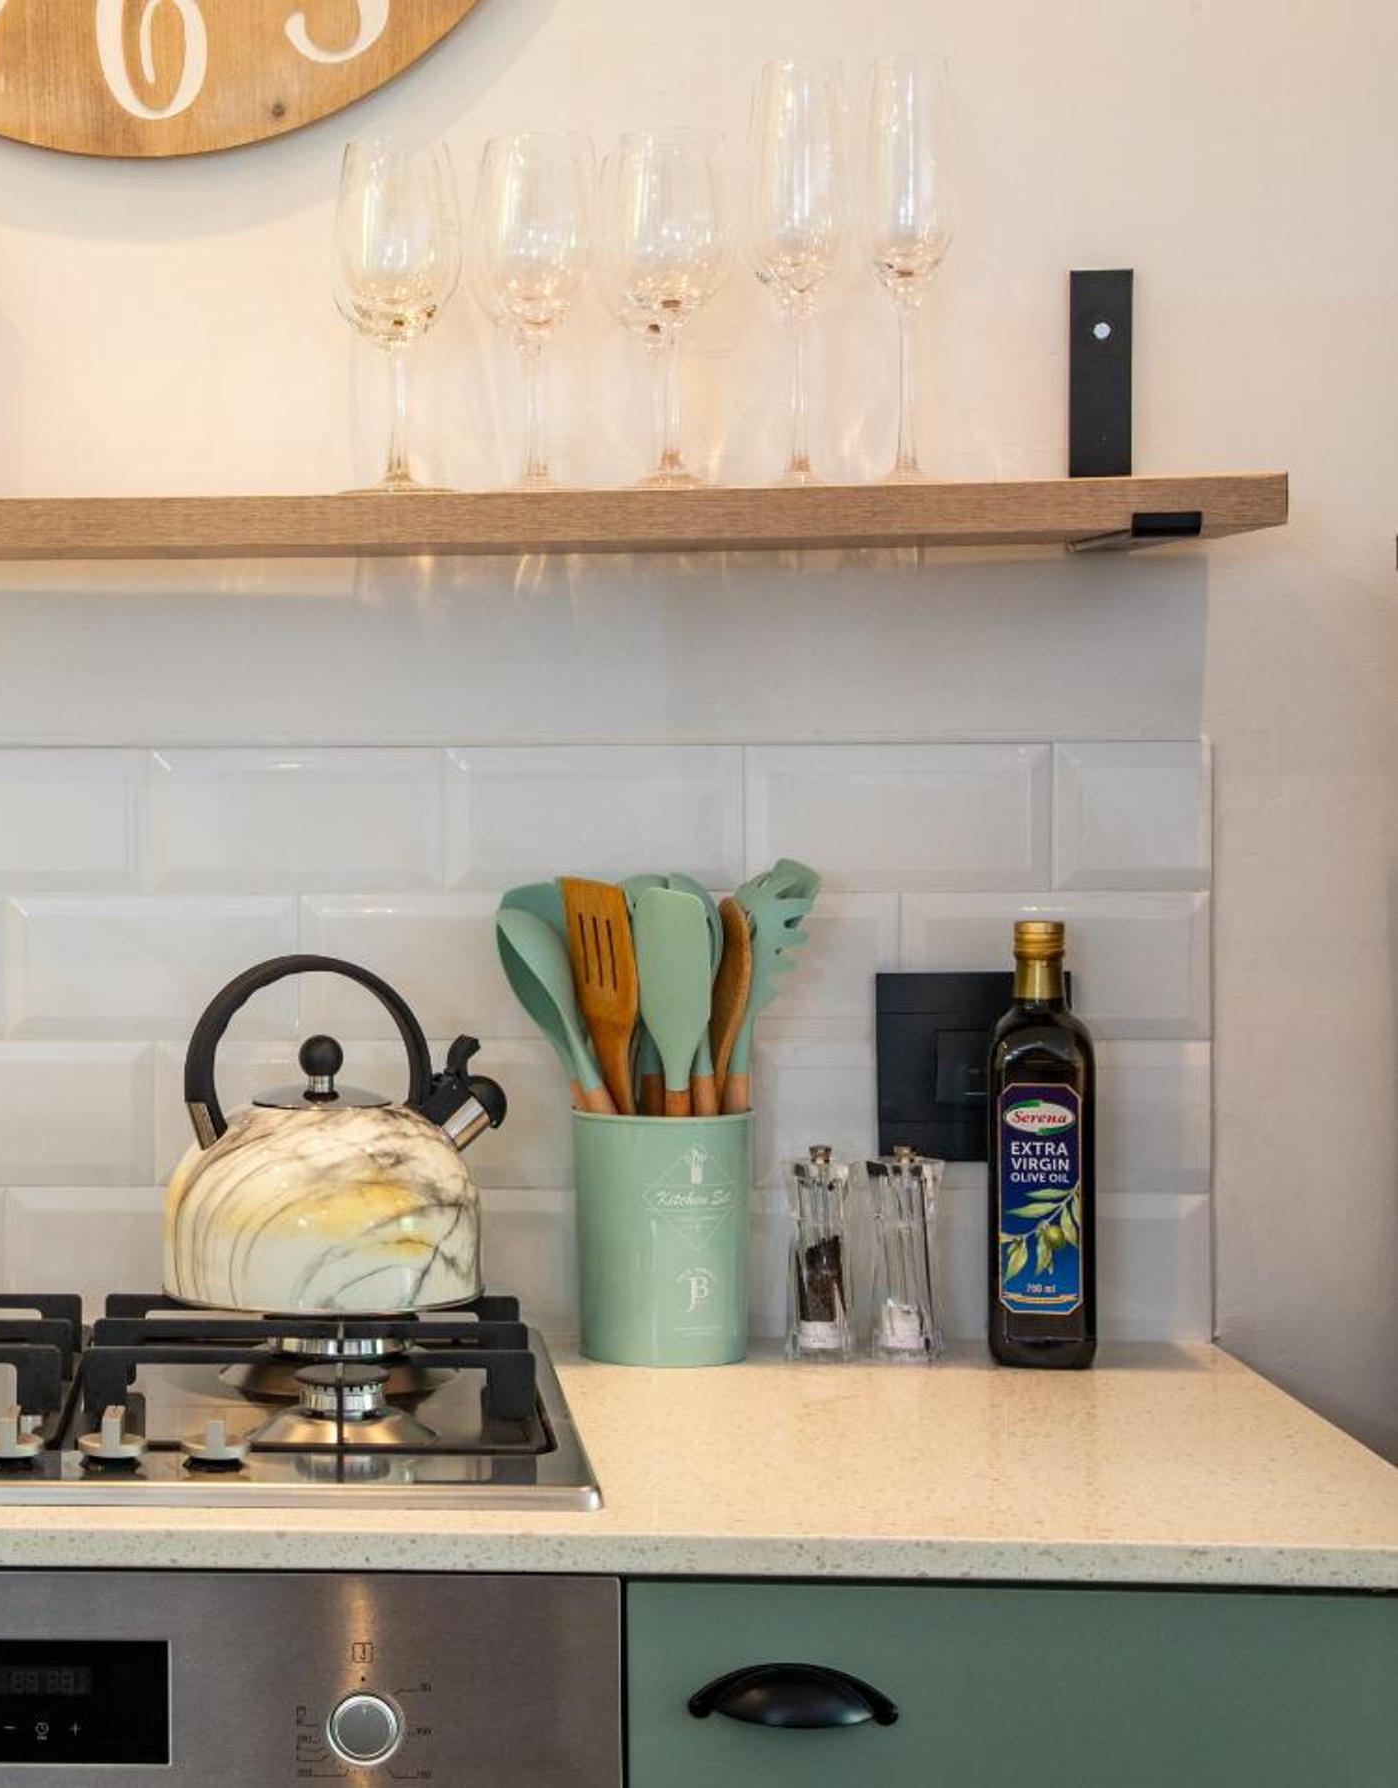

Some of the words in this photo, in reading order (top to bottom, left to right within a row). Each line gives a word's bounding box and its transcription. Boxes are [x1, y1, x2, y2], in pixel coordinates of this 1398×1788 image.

[1012, 1109, 1068, 1124] Serena
[1011, 1141, 1069, 1156] EXTRA
[1011, 1157, 1070, 1171] VIRGIN
[1010, 1172, 1046, 1183] OLIVE
[1049, 1172, 1070, 1183] OIL
